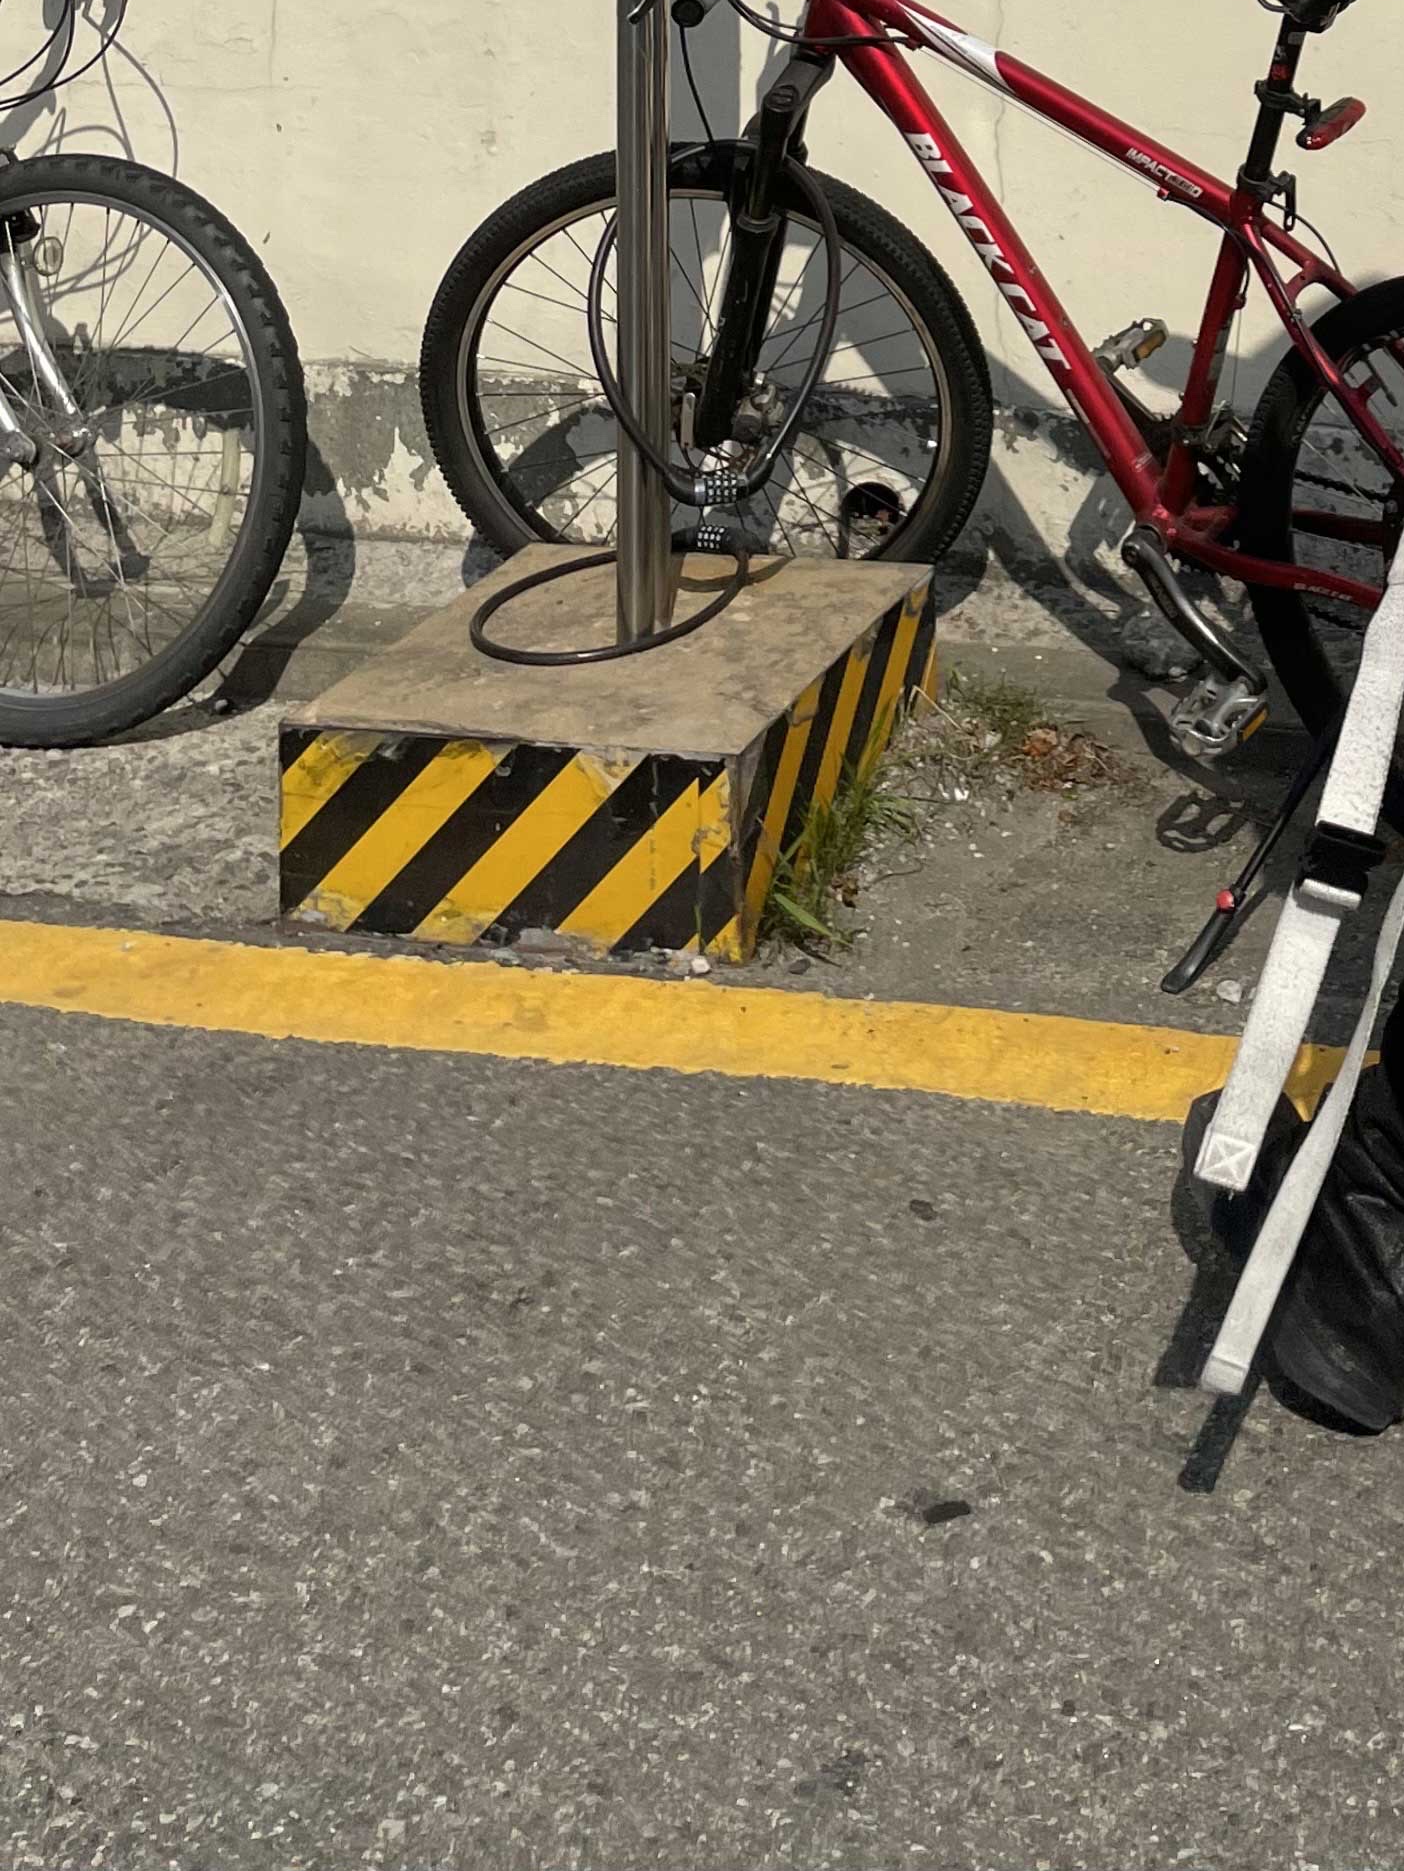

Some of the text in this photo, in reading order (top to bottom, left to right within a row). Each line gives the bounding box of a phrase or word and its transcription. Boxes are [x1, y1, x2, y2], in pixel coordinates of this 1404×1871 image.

[1126, 147, 1177, 181] IMPACT
[904, 132, 1015, 274] BLACK
[999, 282, 1073, 370] CAT
